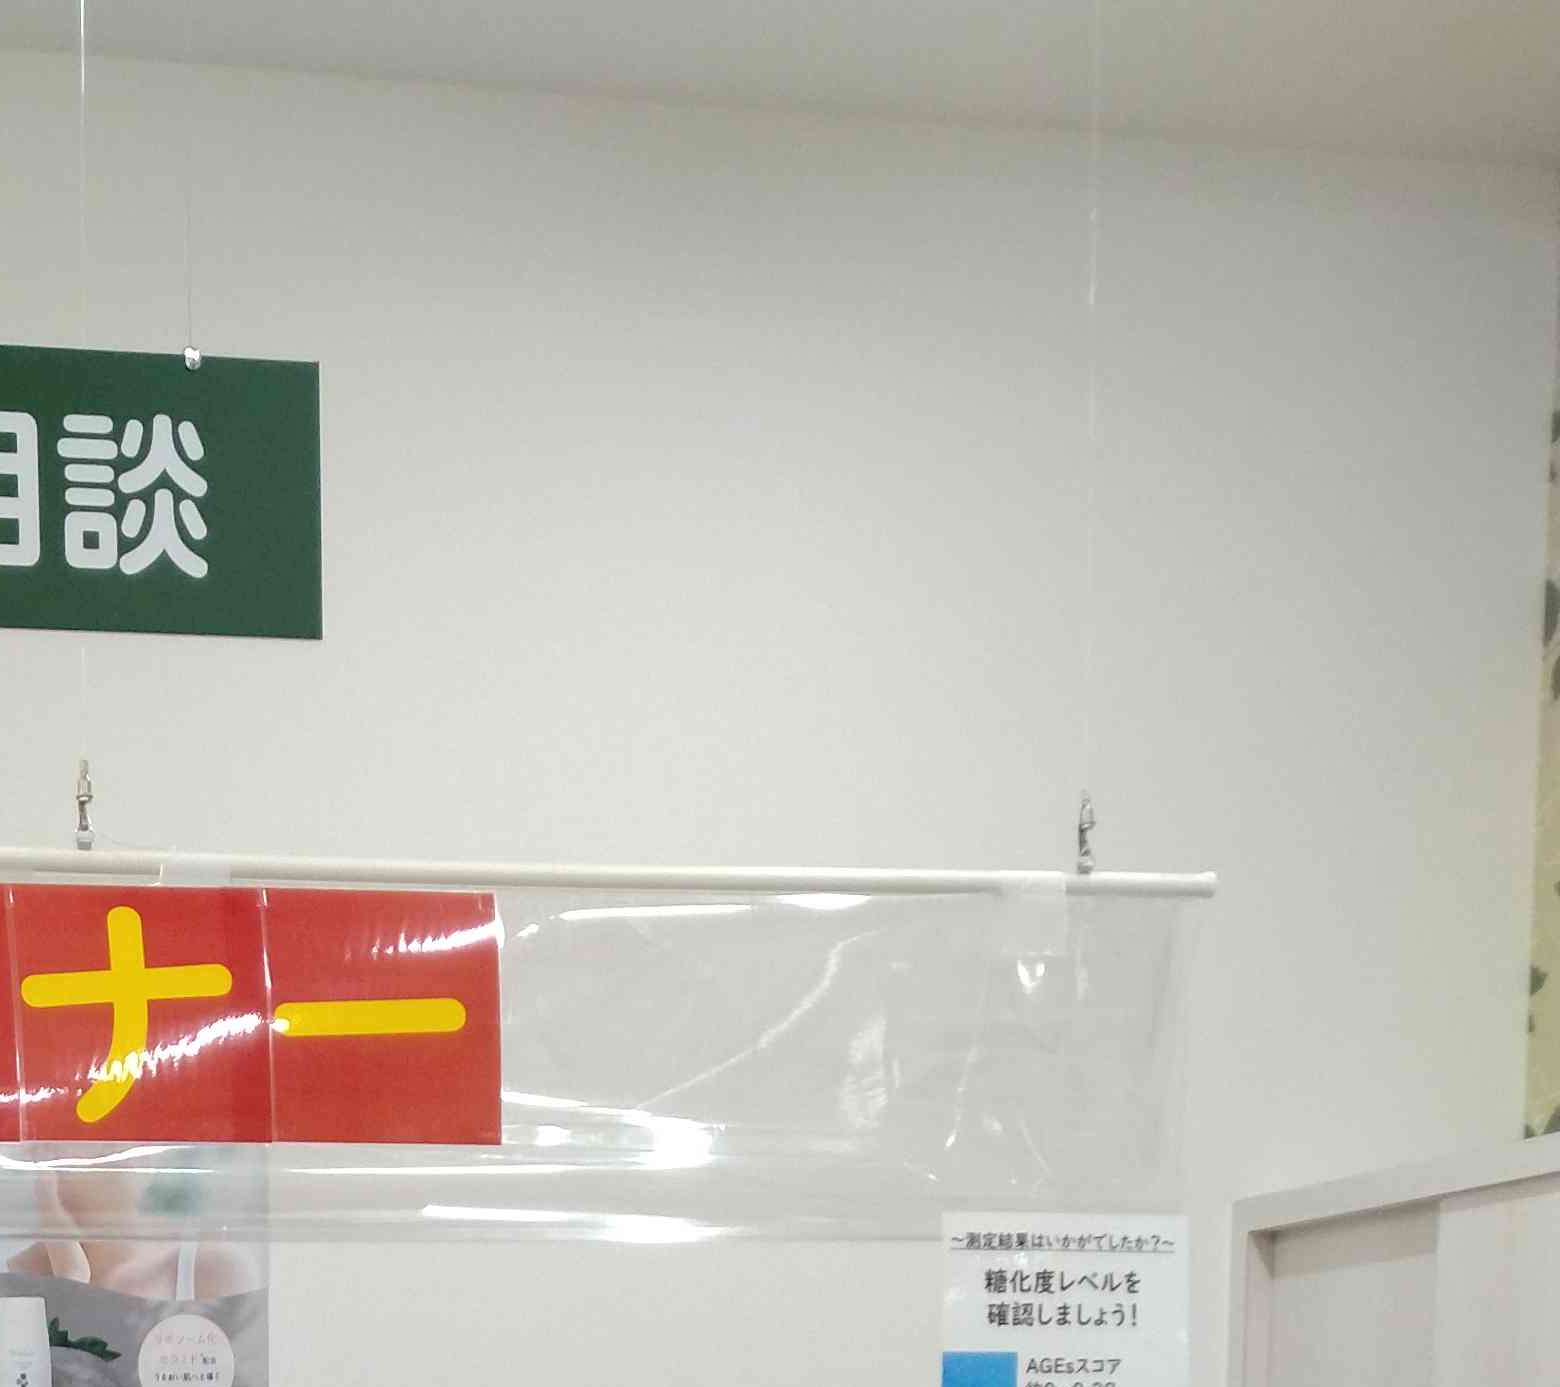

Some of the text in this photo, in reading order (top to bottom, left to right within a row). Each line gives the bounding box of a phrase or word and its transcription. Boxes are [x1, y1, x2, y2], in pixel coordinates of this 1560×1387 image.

[984, 1269, 1142, 1294] 糖化度レベルを
[1026, 1358, 1122, 1374] AGEsスコア
